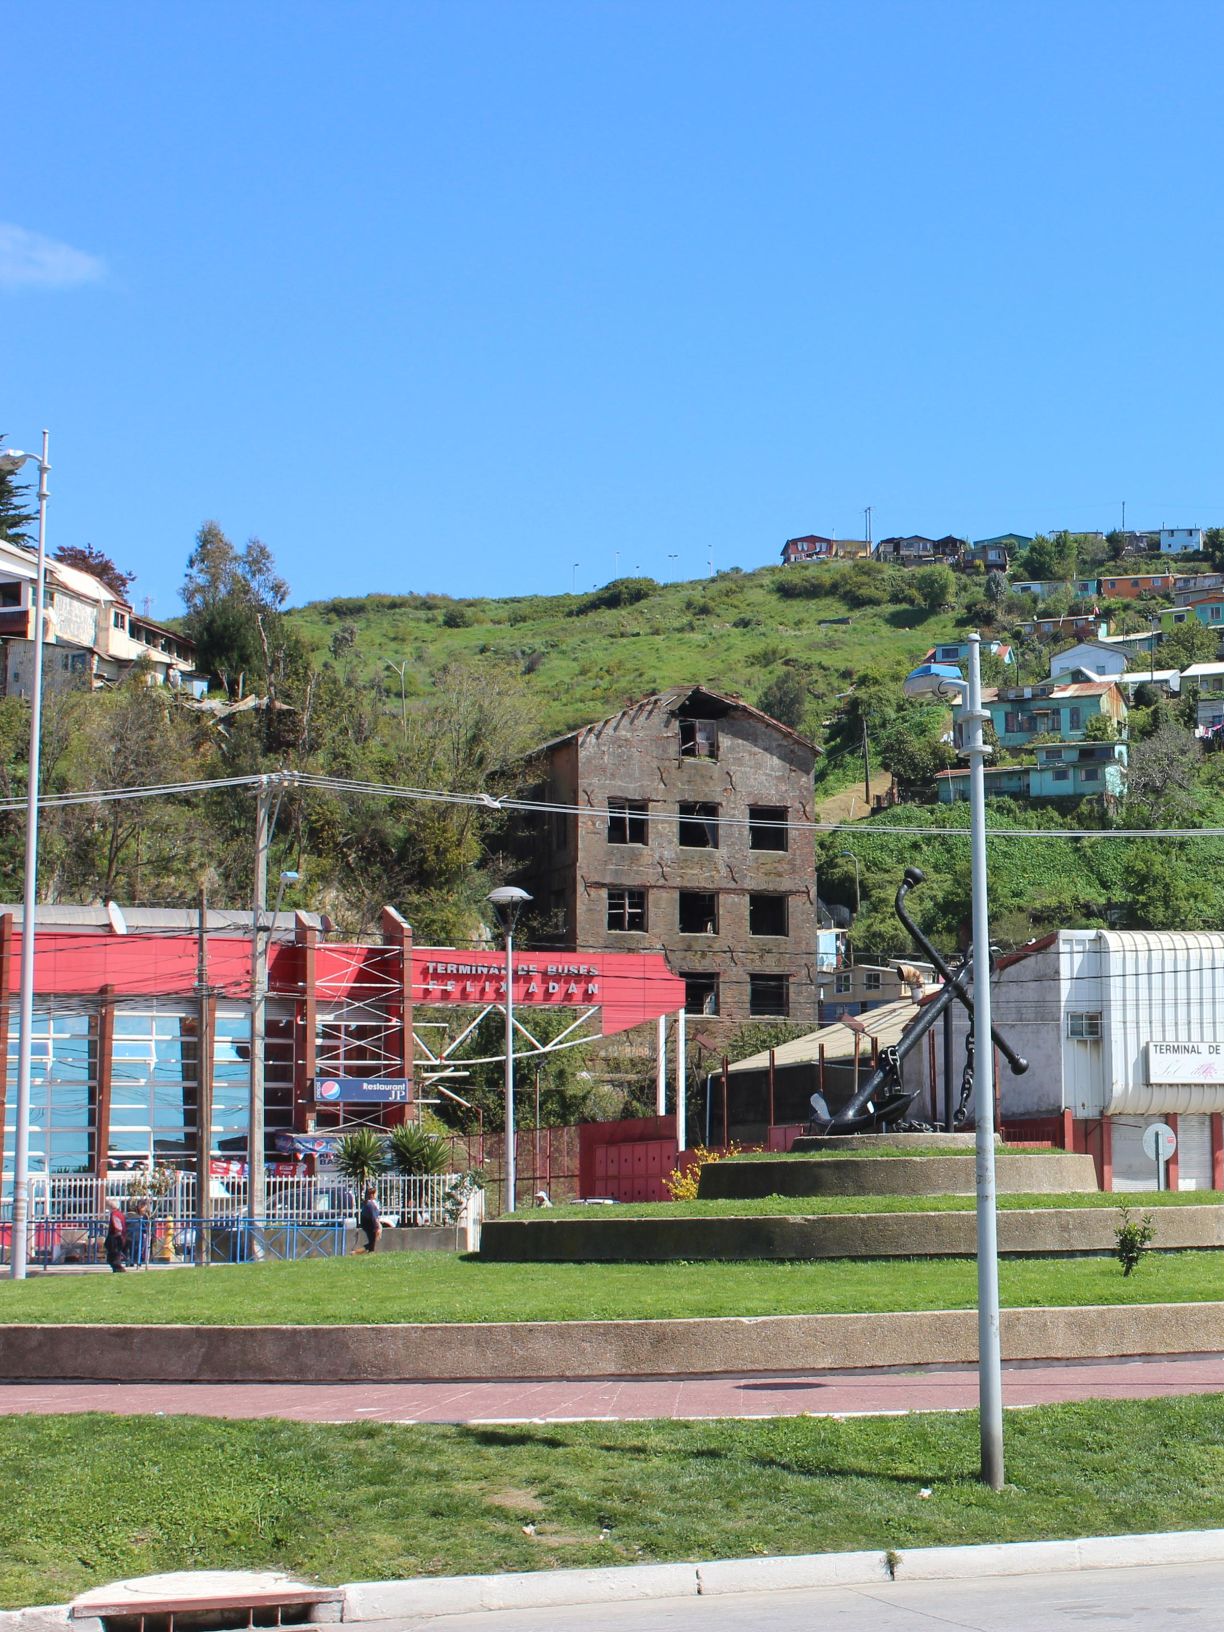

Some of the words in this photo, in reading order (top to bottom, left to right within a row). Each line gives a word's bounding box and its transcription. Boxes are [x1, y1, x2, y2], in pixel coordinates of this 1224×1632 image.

[518, 964, 538, 975] DE
[547, 965, 598, 976] BUSES
[528, 982, 598, 994] ADAN
[1153, 1044, 1202, 1055] TERMINAL
[1208, 1045, 1221, 1055] DE
[363, 1082, 405, 1091] Restaurant
[388, 1091, 405, 1100] JP
